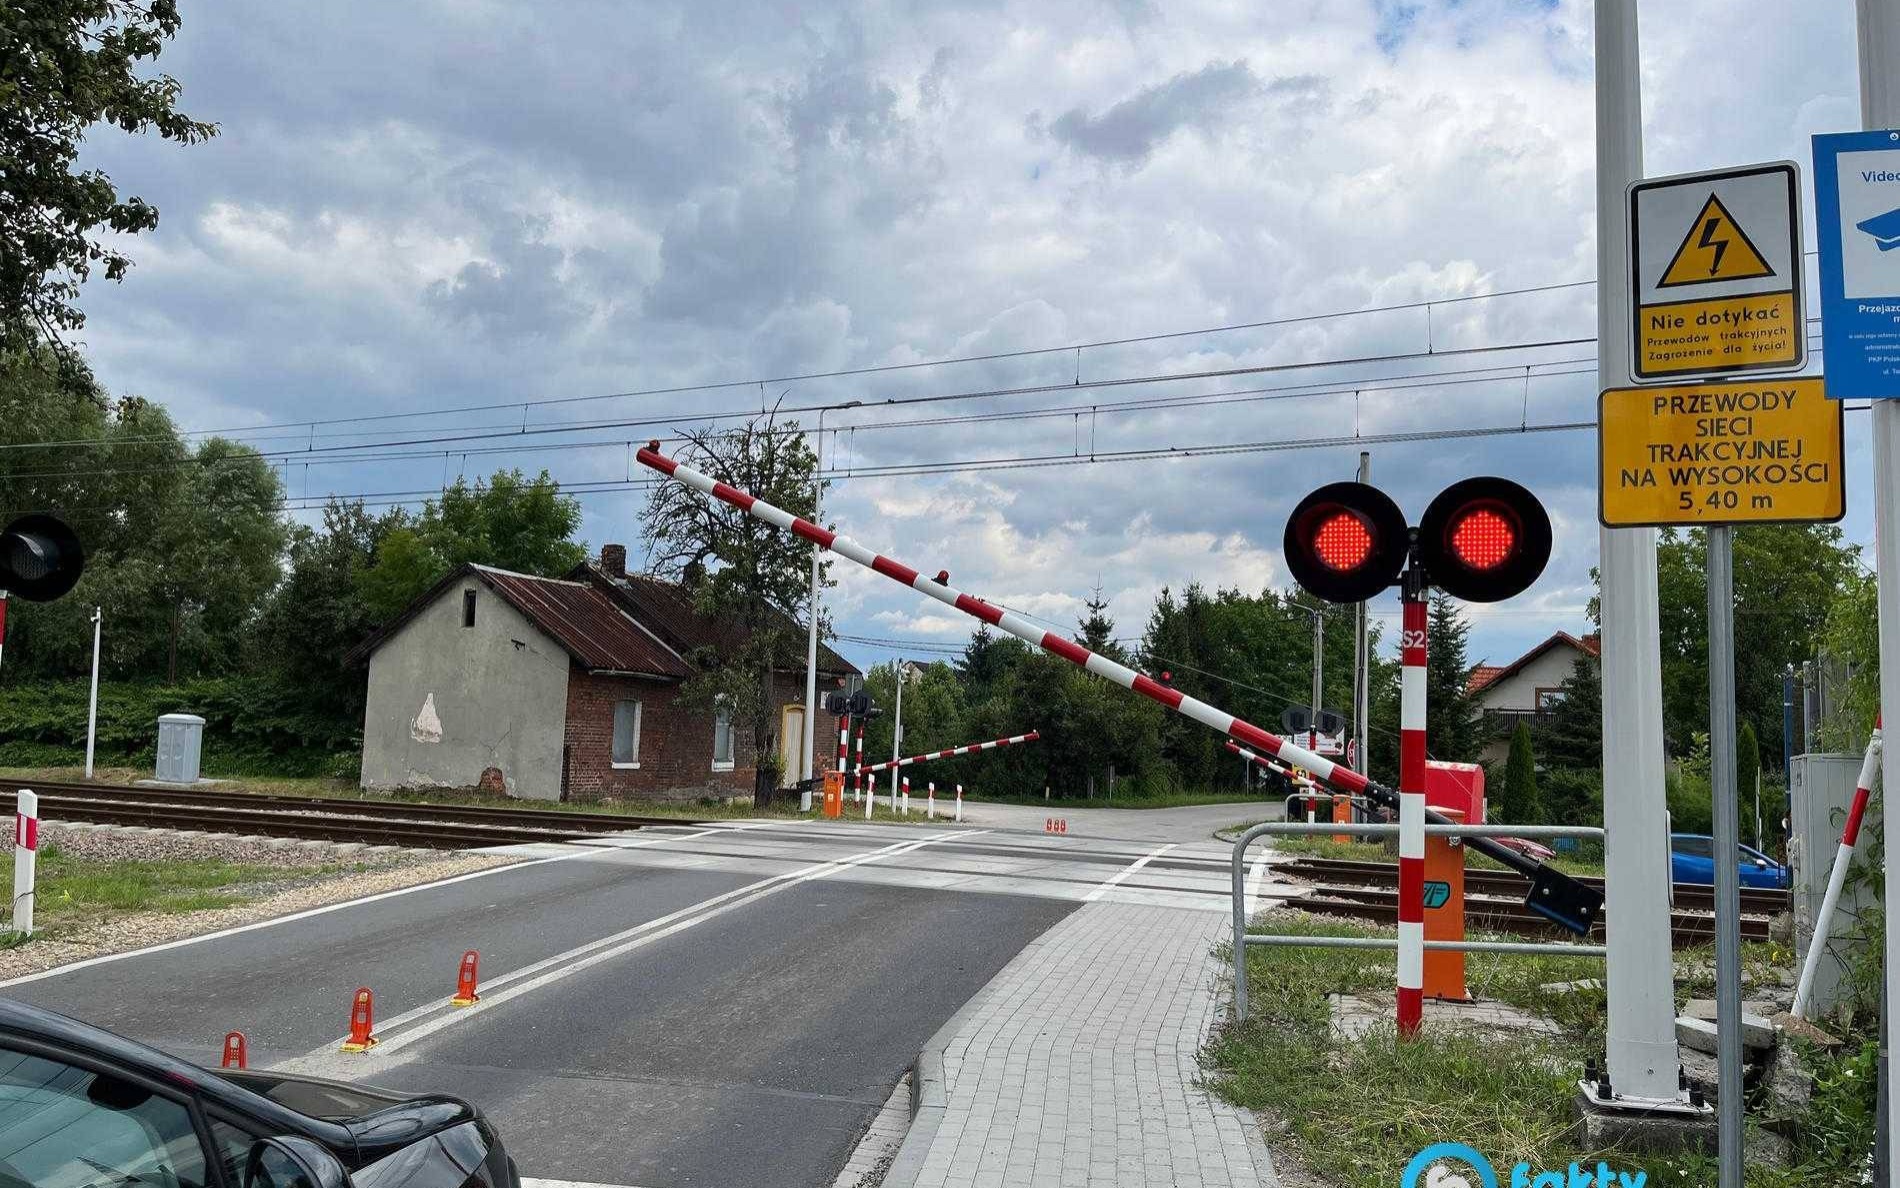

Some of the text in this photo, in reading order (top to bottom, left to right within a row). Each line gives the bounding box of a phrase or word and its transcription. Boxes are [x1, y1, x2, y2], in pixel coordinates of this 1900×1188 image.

[1651, 304, 1780, 330] Nie dotykać
[1719, 326, 1787, 341] trakcyjnych
[1653, 390, 1797, 415] PRZEWODY
[1695, 416, 1753, 437] SIECI
[1646, 439, 1802, 463] TRAKCYJNEJ
[1621, 459, 1829, 488] NA WYSOKOŚCI
[1751, 496, 1773, 509] m
[1403, 630, 1425, 648] S2
